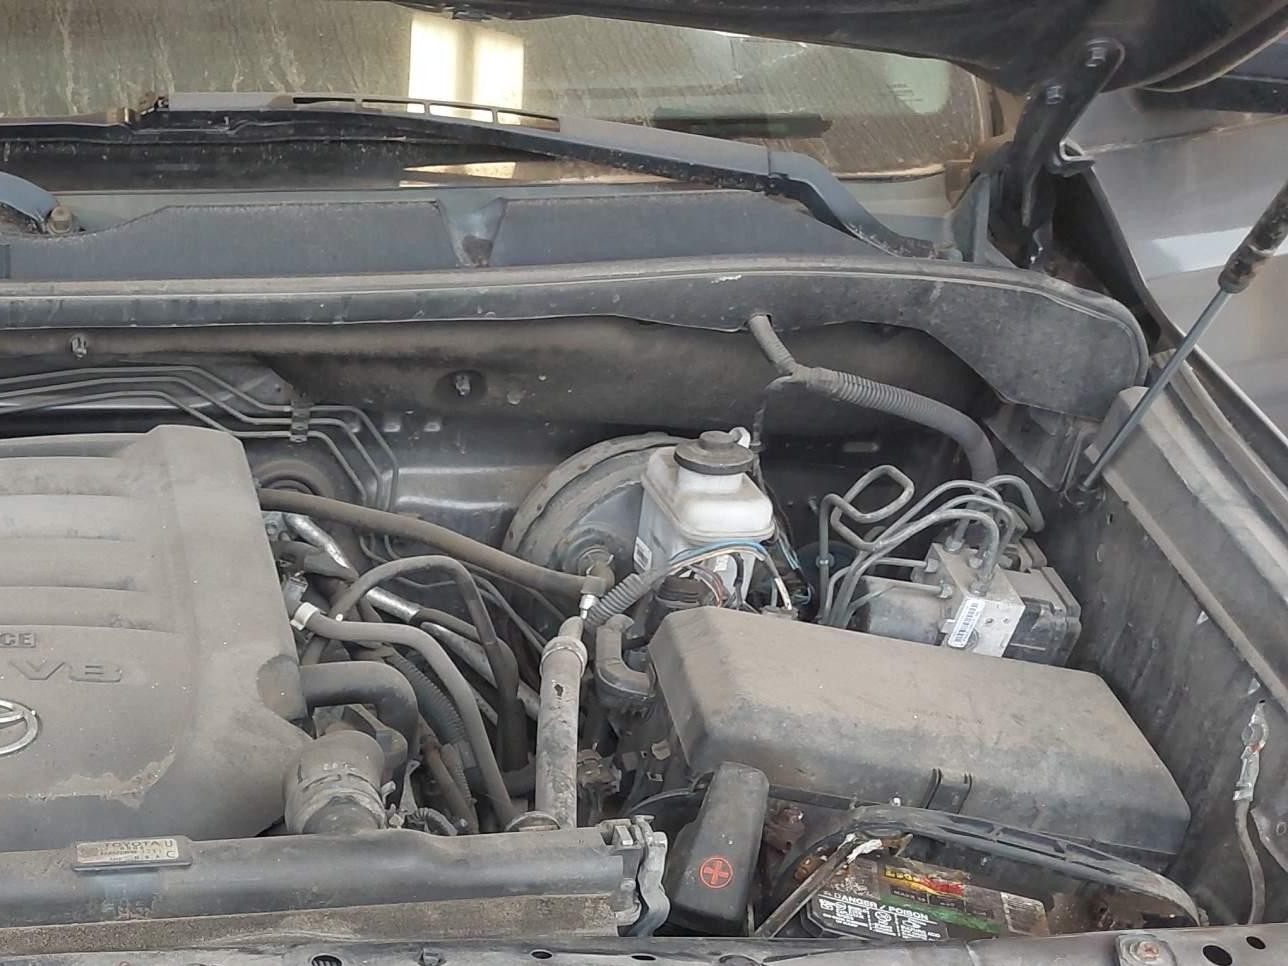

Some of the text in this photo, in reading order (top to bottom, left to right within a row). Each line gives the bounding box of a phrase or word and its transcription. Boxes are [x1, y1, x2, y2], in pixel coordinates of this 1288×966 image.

[9, 659, 122, 683] V8
[103, 840, 160, 849] TOYOTA
[833, 892, 877, 909] DANGER
[888, 905, 929, 921] POISON
